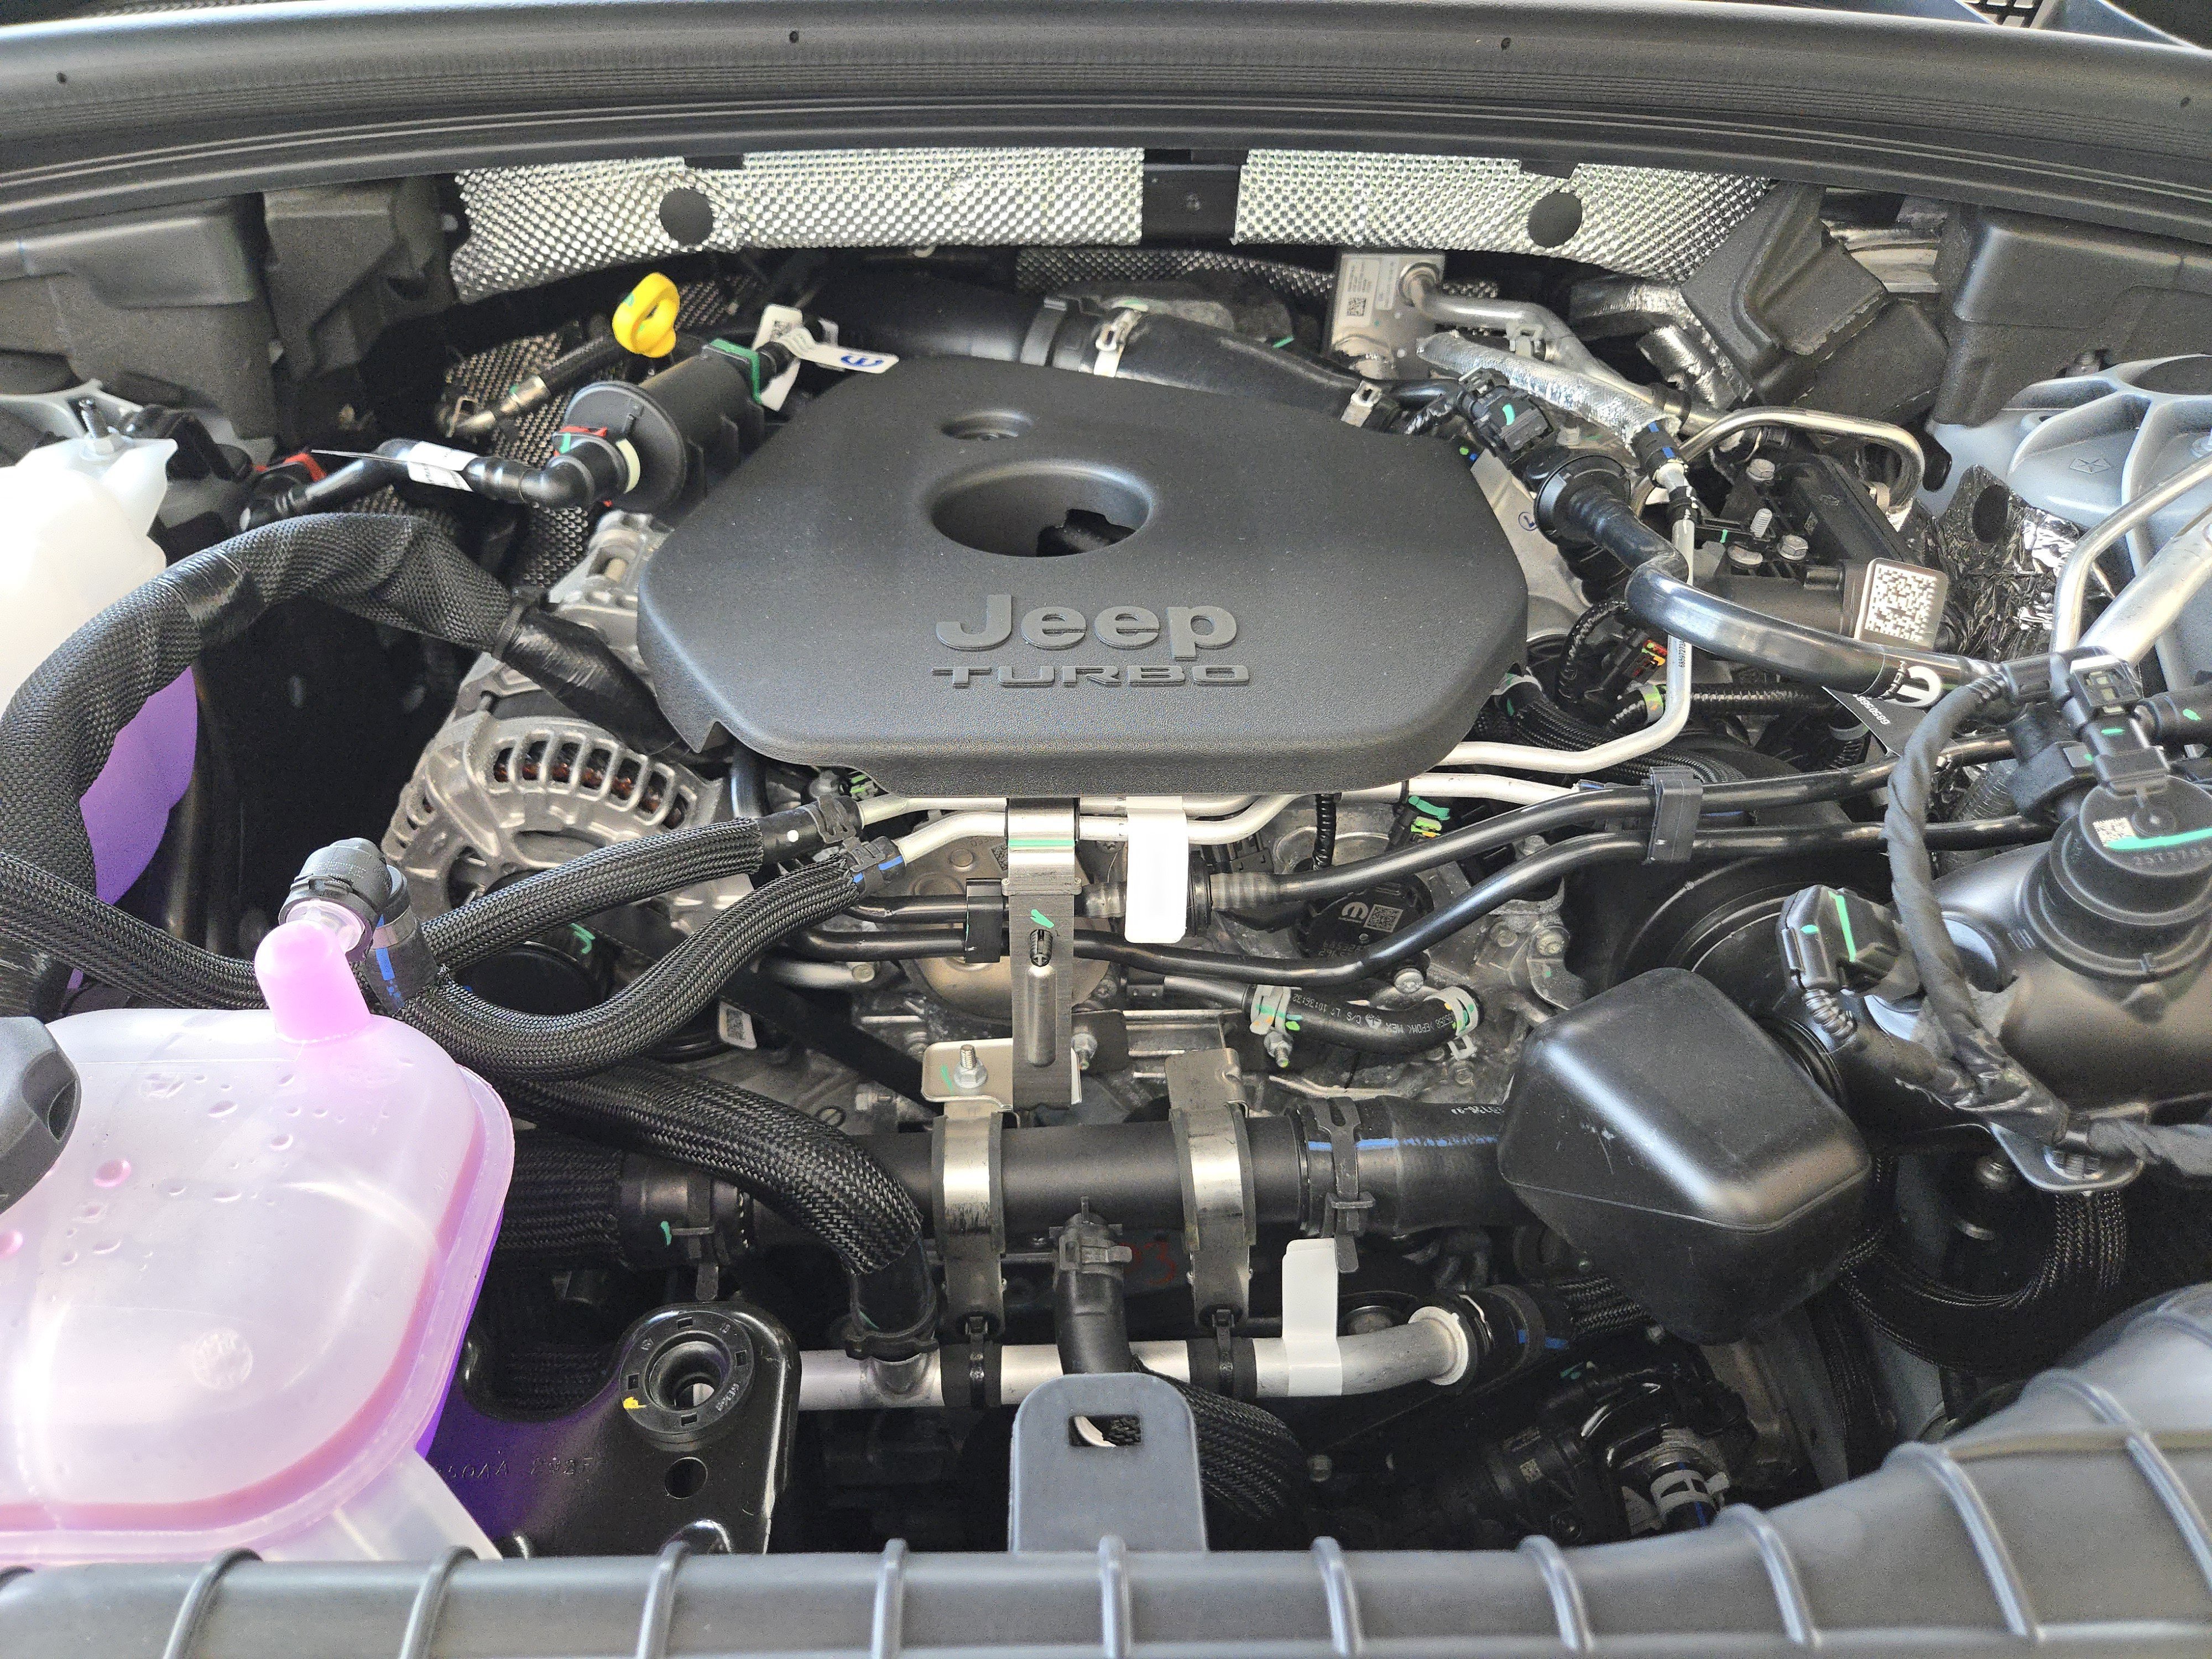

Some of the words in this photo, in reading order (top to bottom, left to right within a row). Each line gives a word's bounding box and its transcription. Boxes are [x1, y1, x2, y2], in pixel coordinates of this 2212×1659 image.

[936, 594, 1238, 660] Jeep
[932, 665, 1250, 687] TURBO
[1292, 993, 1328, 1014] 10:36:32
[1385, 1021, 1405, 1035] MEX
